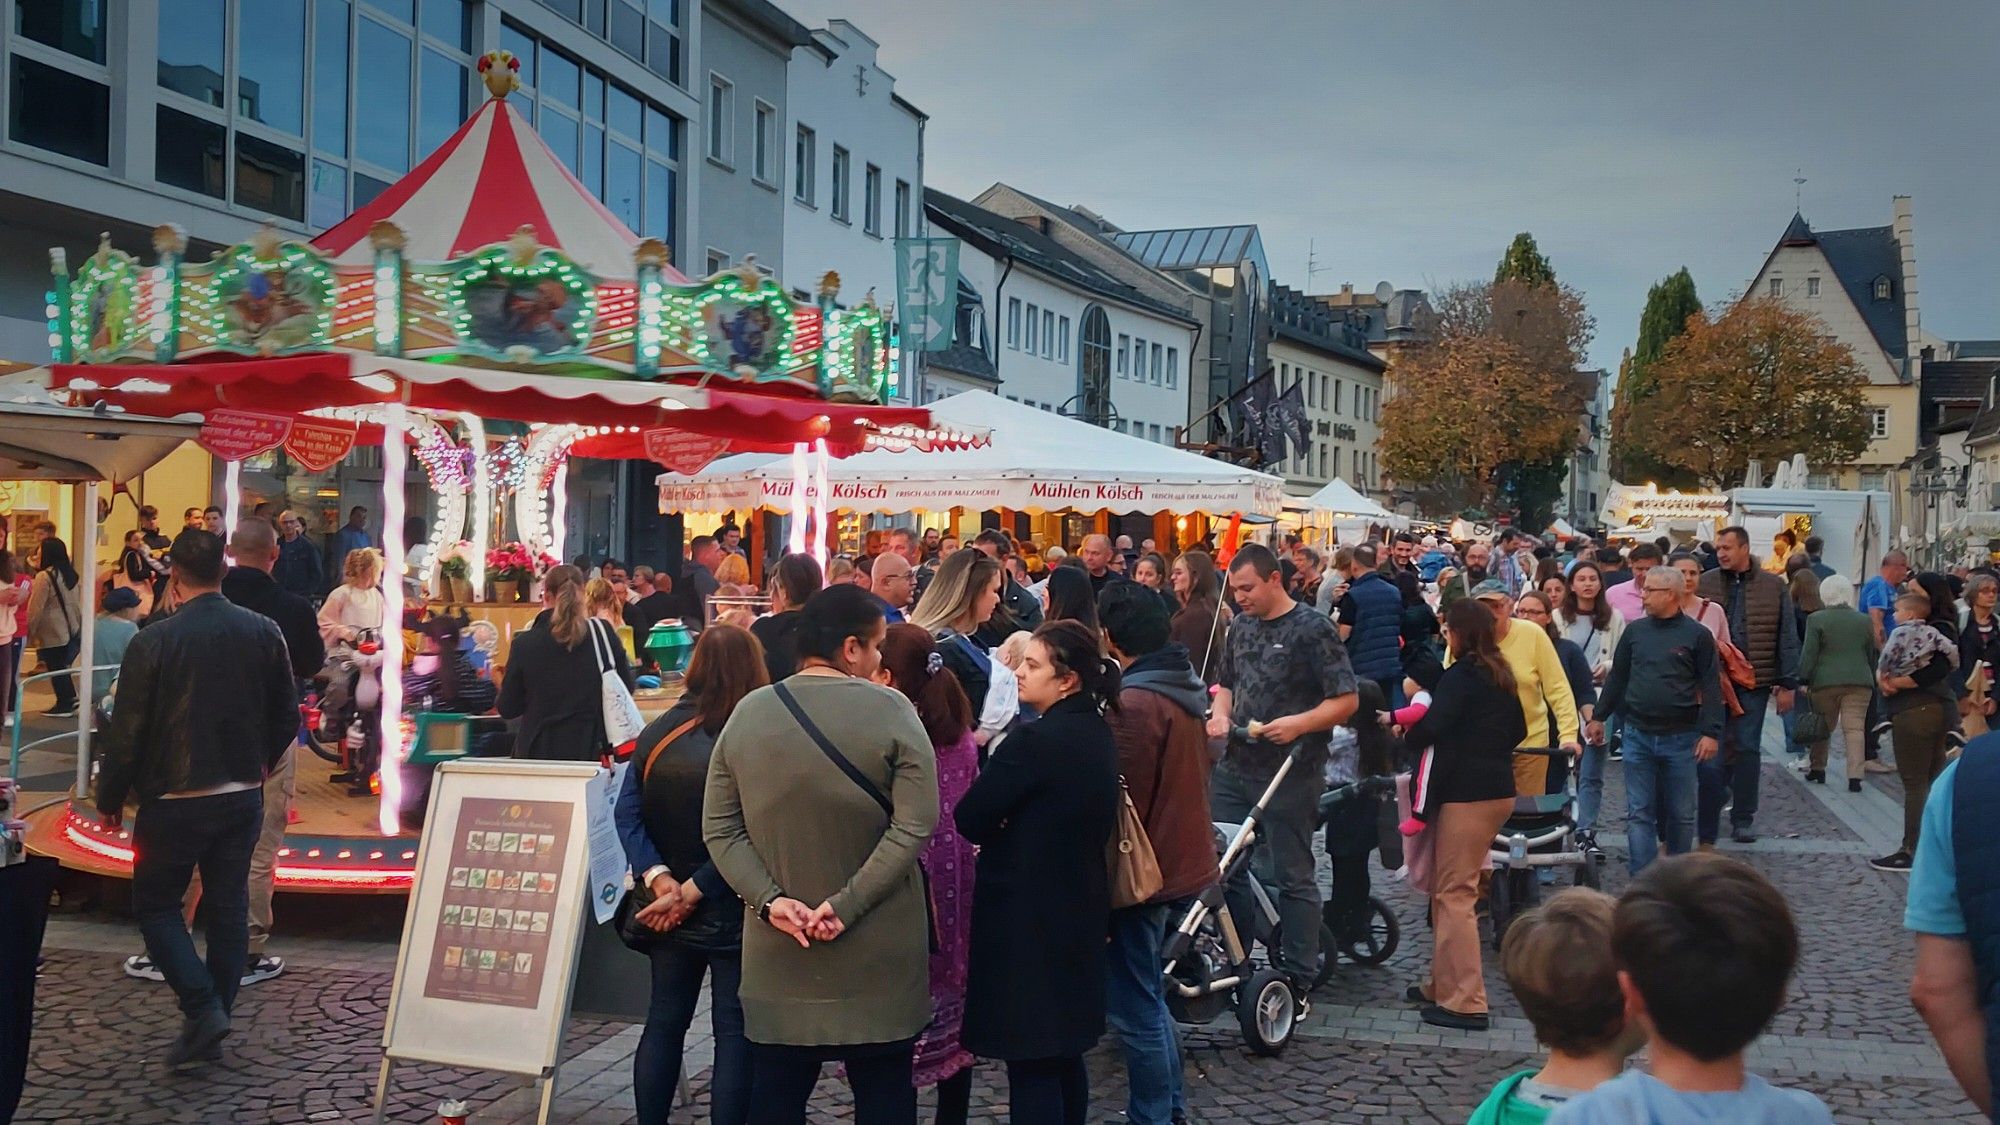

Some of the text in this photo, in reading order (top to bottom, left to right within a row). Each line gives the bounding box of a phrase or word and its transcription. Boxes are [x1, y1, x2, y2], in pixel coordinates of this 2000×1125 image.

[761, 481, 820, 497] Müe
[832, 483, 887, 499] Kölsch
[1030, 482, 1144, 500] Mühlen Kölsch
